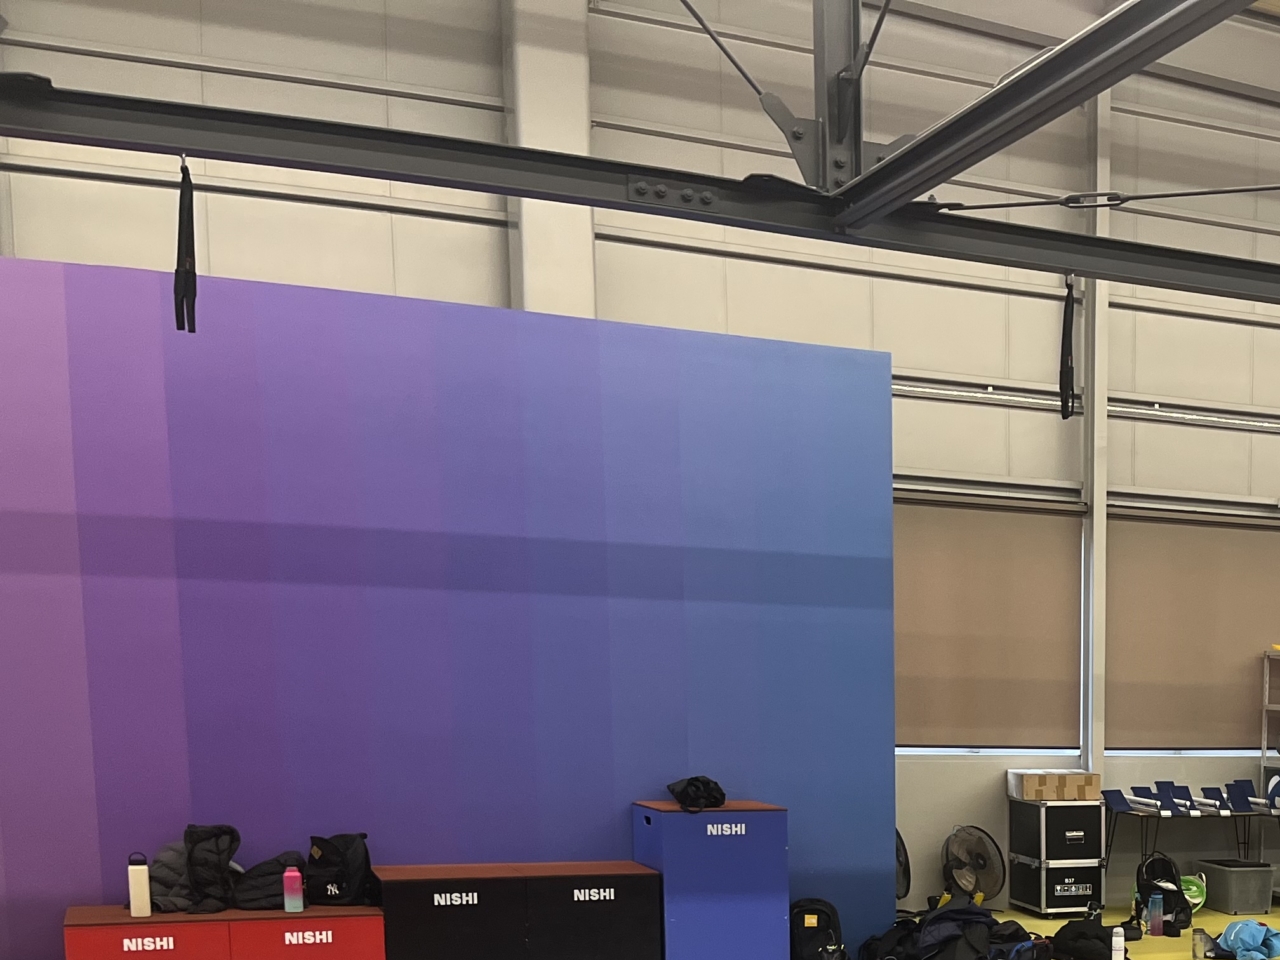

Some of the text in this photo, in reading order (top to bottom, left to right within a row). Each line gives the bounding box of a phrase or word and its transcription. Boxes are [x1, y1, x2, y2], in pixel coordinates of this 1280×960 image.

[706, 823, 746, 836] NISHI
[433, 892, 479, 906] NISHI
[573, 888, 615, 901] NISHI
[123, 936, 175, 952] NISHI
[284, 930, 333, 945] NISHI
